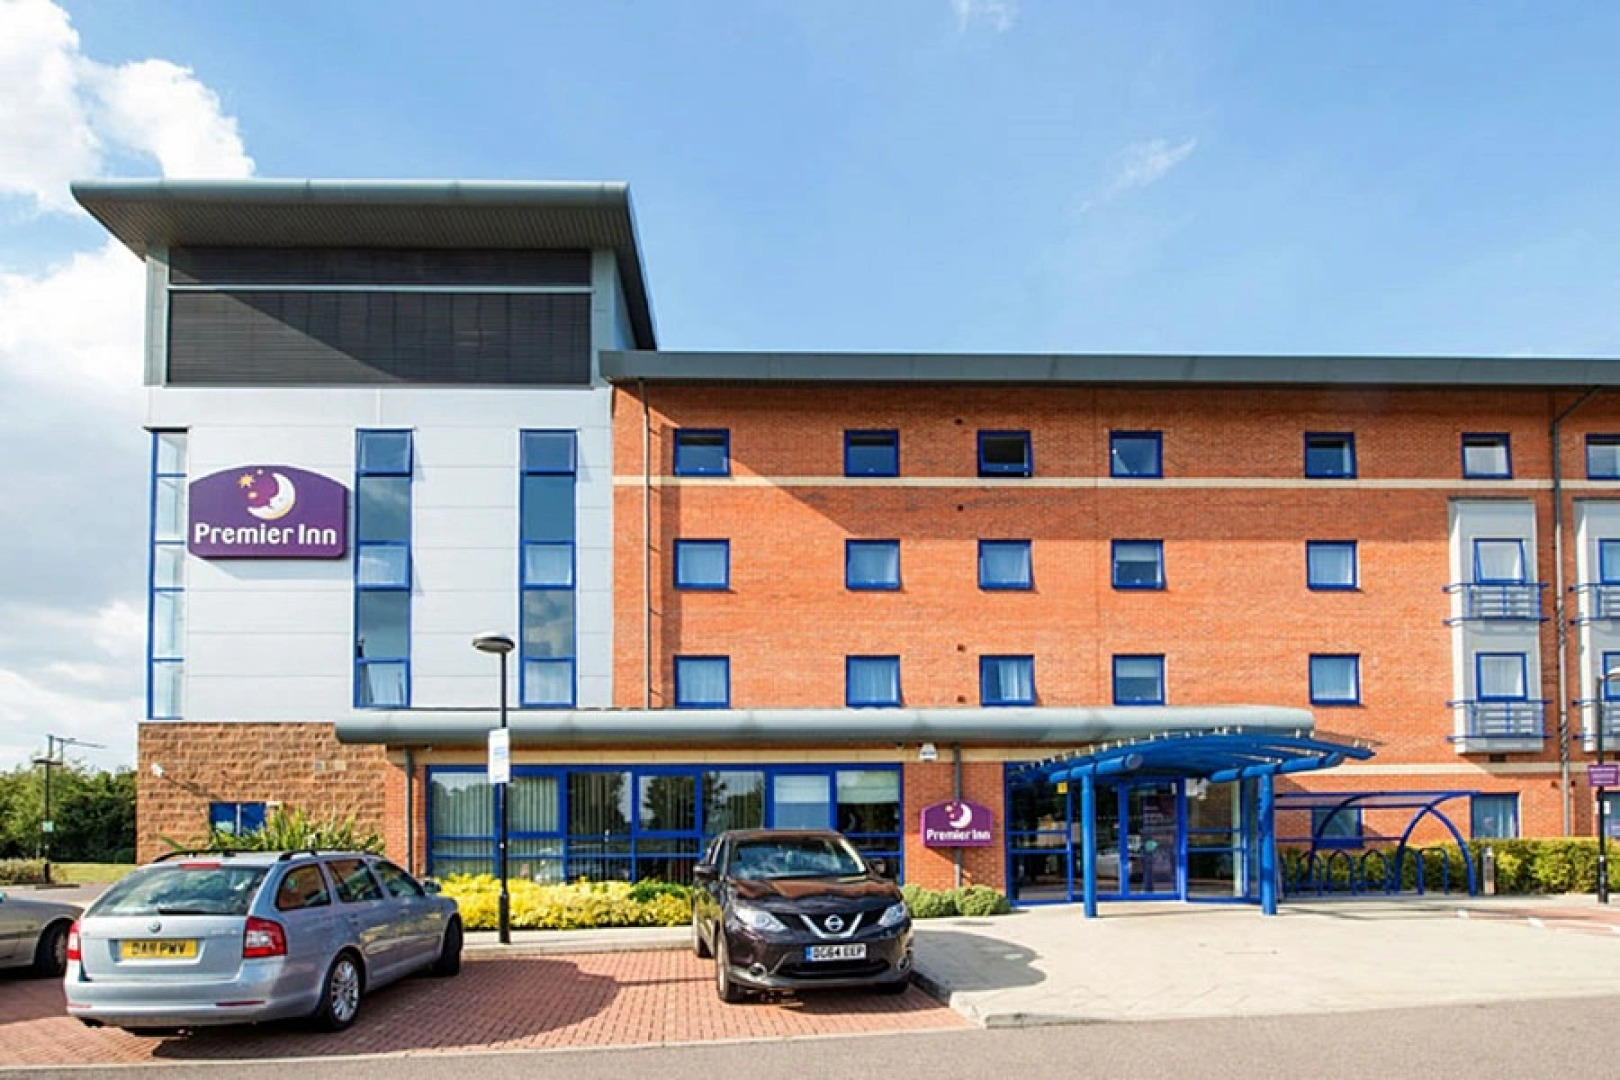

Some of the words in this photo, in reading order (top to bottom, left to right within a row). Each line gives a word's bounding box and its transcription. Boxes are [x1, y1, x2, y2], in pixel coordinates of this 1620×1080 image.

[194, 522, 294, 545] Premier
[298, 523, 338, 546] Inn
[926, 828, 971, 841] Premier
[971, 828, 991, 840] Inn
